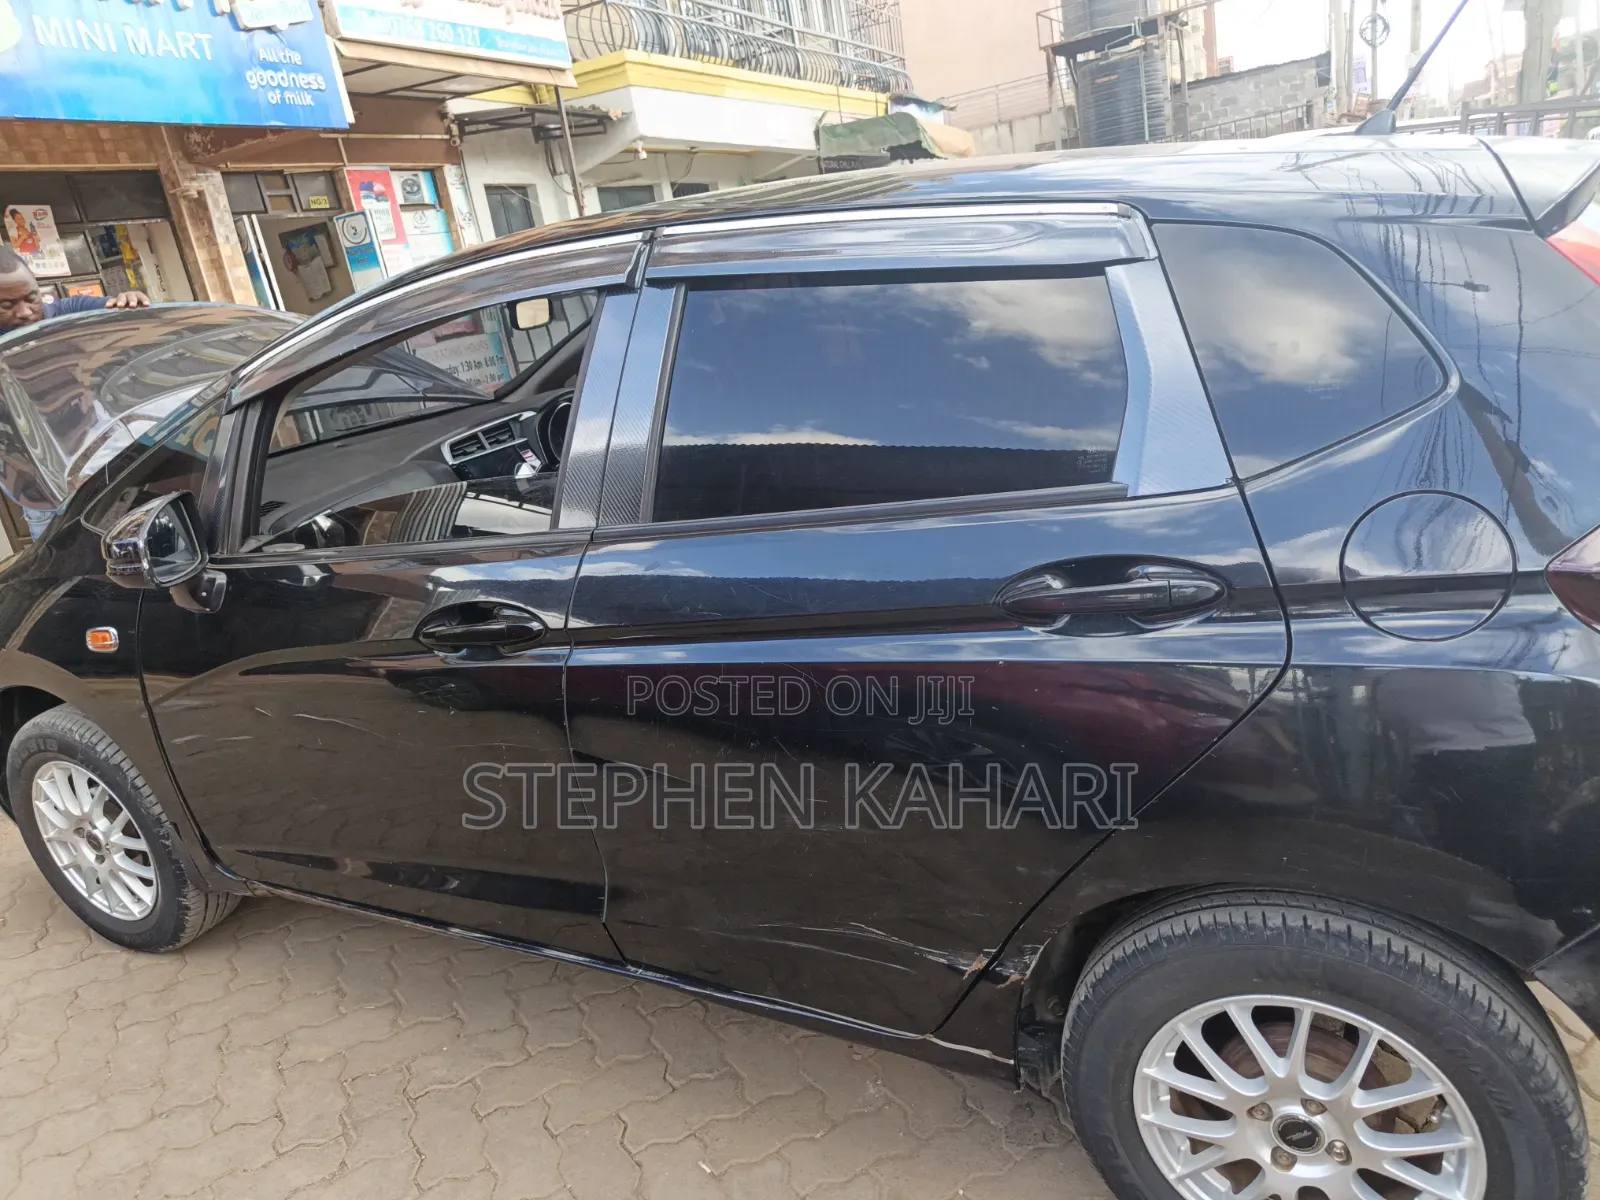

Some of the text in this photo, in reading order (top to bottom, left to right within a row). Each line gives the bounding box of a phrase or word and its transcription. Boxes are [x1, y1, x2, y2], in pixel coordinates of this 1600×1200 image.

[32, 14, 213, 61] MINI MART
[458, 25, 481, 46] 121
[259, 48, 303, 65] All the
[245, 68, 327, 91] goodness
[267, 88, 315, 106] of milk
